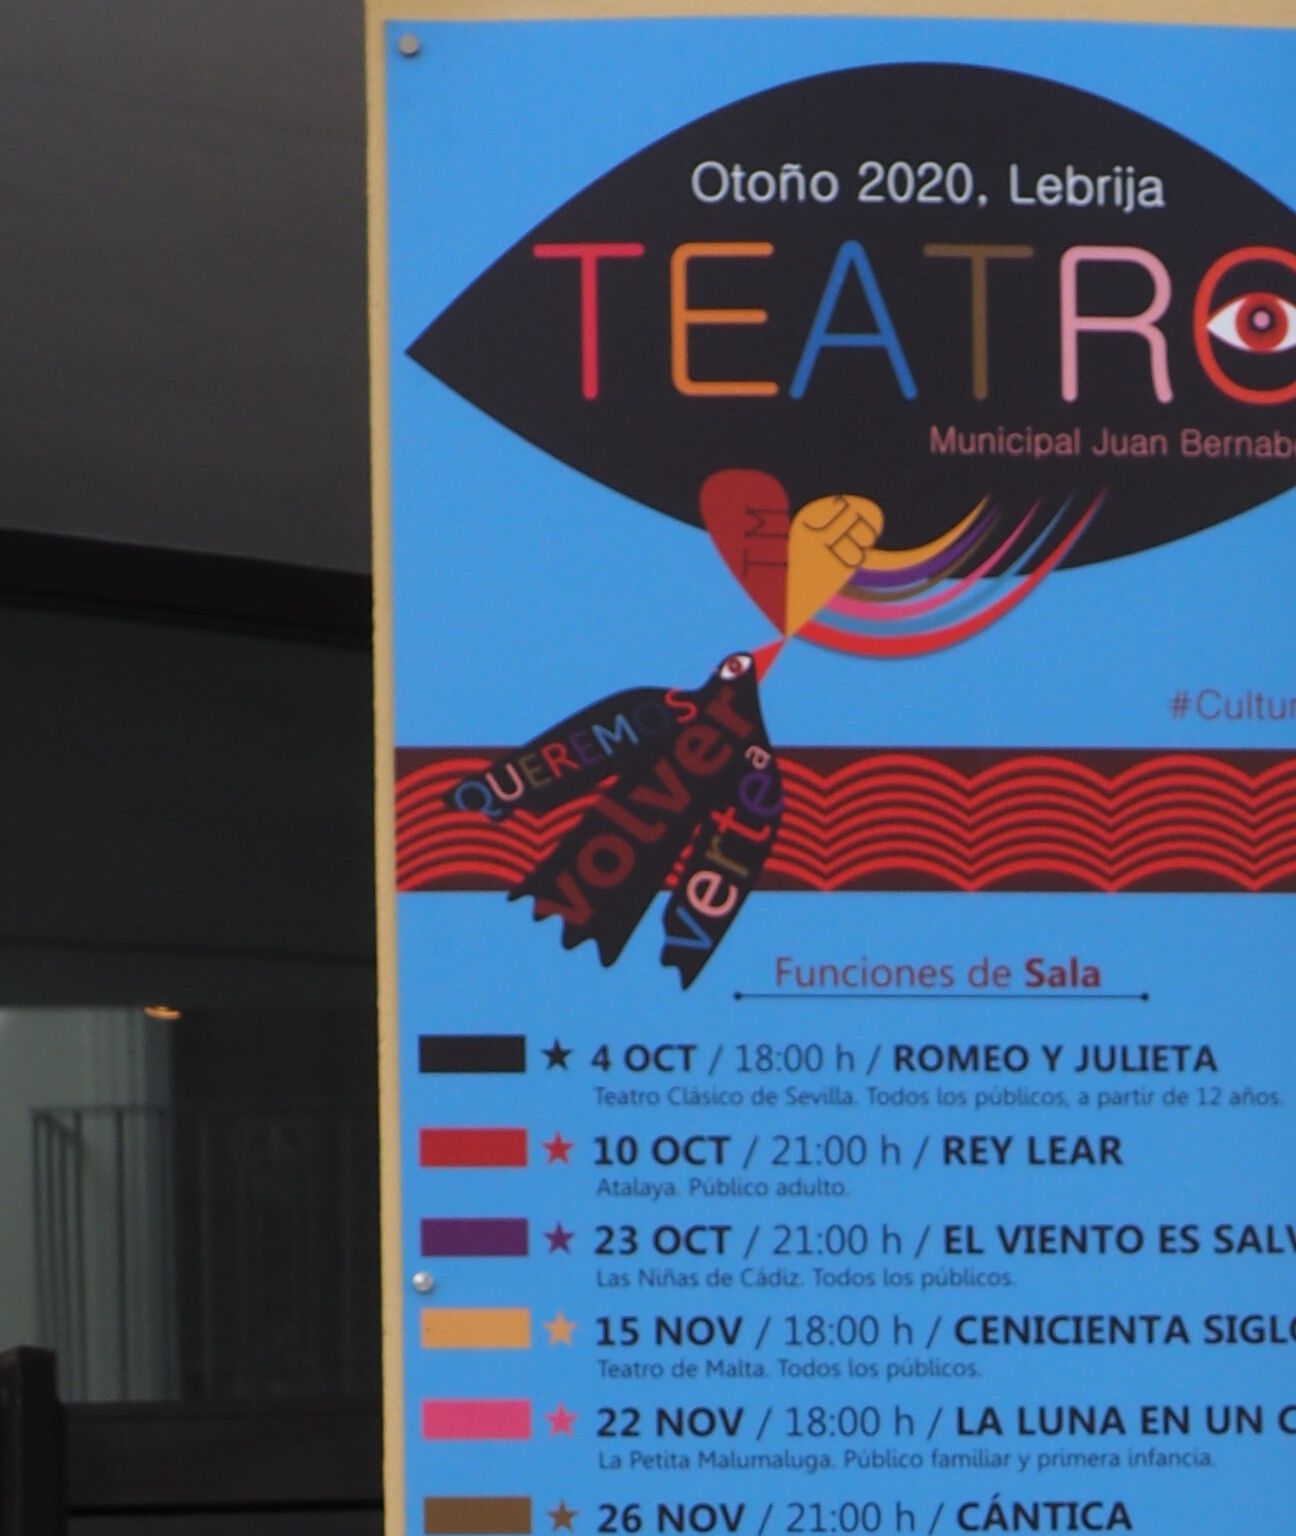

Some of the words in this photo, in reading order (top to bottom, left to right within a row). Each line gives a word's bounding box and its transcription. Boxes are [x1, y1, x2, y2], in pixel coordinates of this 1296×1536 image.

[692, 161, 839, 203] Otoño
[858, 161, 987, 206] 2020,
[1010, 164, 1165, 213] Lebrija
[931, 426, 1080, 458] Municipal
[1092, 428, 1168, 457] Juan
[453, 688, 699, 819] QUEREMOS
[534, 688, 754, 925] volver
[777, 957, 954, 987] Funciones
[968, 958, 1011, 987] de
[1025, 956, 1101, 988] Sala
[591, 1045, 611, 1071] 4
[624, 1044, 696, 1072] OCT
[738, 1045, 822, 1071] 18:00
[837, 1046, 853, 1070] h
[894, 1045, 1029, 1072] ROMEO
[1042, 1045, 1062, 1072] Y
[1075, 1045, 1217, 1072] JULIETA
[594, 1086, 660, 1106] Teatro
[667, 1087, 743, 1106] Clásico
[751, 1088, 778, 1106] de
[867, 1087, 930, 1106] Todos
[937, 1087, 967, 1106] los
[1097, 1090, 1155, 1110] partir
[1162, 1088, 1189, 1106] de
[1199, 1087, 1222, 1106] 12
[595, 1136, 638, 1166] 10
[652, 1135, 731, 1165] OCT
[773, 1136, 866, 1165] 21:00
[882, 1136, 900, 1164] h
[944, 1136, 1012, 1165] REY
[1028, 1136, 1123, 1165] LEAR
[689, 1178, 768, 1197] Público
[595, 1225, 638, 1255] 23
[653, 1225, 731, 1255] OCT
[774, 1225, 867, 1254] 21:00
[883, 1225, 901, 1253] h
[945, 1225, 984, 1254] EL
[997, 1225, 1144, 1254] VIENTO
[1160, 1224, 1200, 1254] ES
[597, 1270, 631, 1287] Las
[638, 1269, 699, 1287] Niñas
[706, 1268, 733, 1287] de
[813, 1268, 875, 1287] Todos
[884, 1268, 914, 1287] los
[597, 1317, 639, 1346] 15
[656, 1316, 742, 1346] NOV
[787, 1316, 878, 1345] 18:00
[895, 1316, 912, 1343] h
[955, 1315, 1190, 1345] CENICIENTA
[598, 1359, 664, 1378] Teatro
[672, 1360, 698, 1378] de
[778, 1359, 841, 1378] Todos
[848, 1359, 878, 1378] los
[597, 1407, 640, 1437] 22
[657, 1407, 744, 1437] NOV
[788, 1407, 880, 1436] 18:00
[896, 1407, 913, 1435] h
[957, 1407, 1003, 1435] LA
[1018, 1406, 1126, 1435] LUNA
[1141, 1406, 1189, 1435] EN
[1206, 1406, 1263, 1435] UN
[599, 1452, 622, 1470] La
[630, 1450, 690, 1469] Petita
[844, 1449, 923, 1468] Público
[931, 1449, 1011, 1468] familiar
[1038, 1453, 1120, 1472] primera
[598, 1504, 642, 1533] 26
[658, 1503, 745, 1533] NOV
[787, 1503, 881, 1532] 21:00
[897, 1502, 914, 1531] h
[957, 1493, 1132, 1532] CÁNTICA
